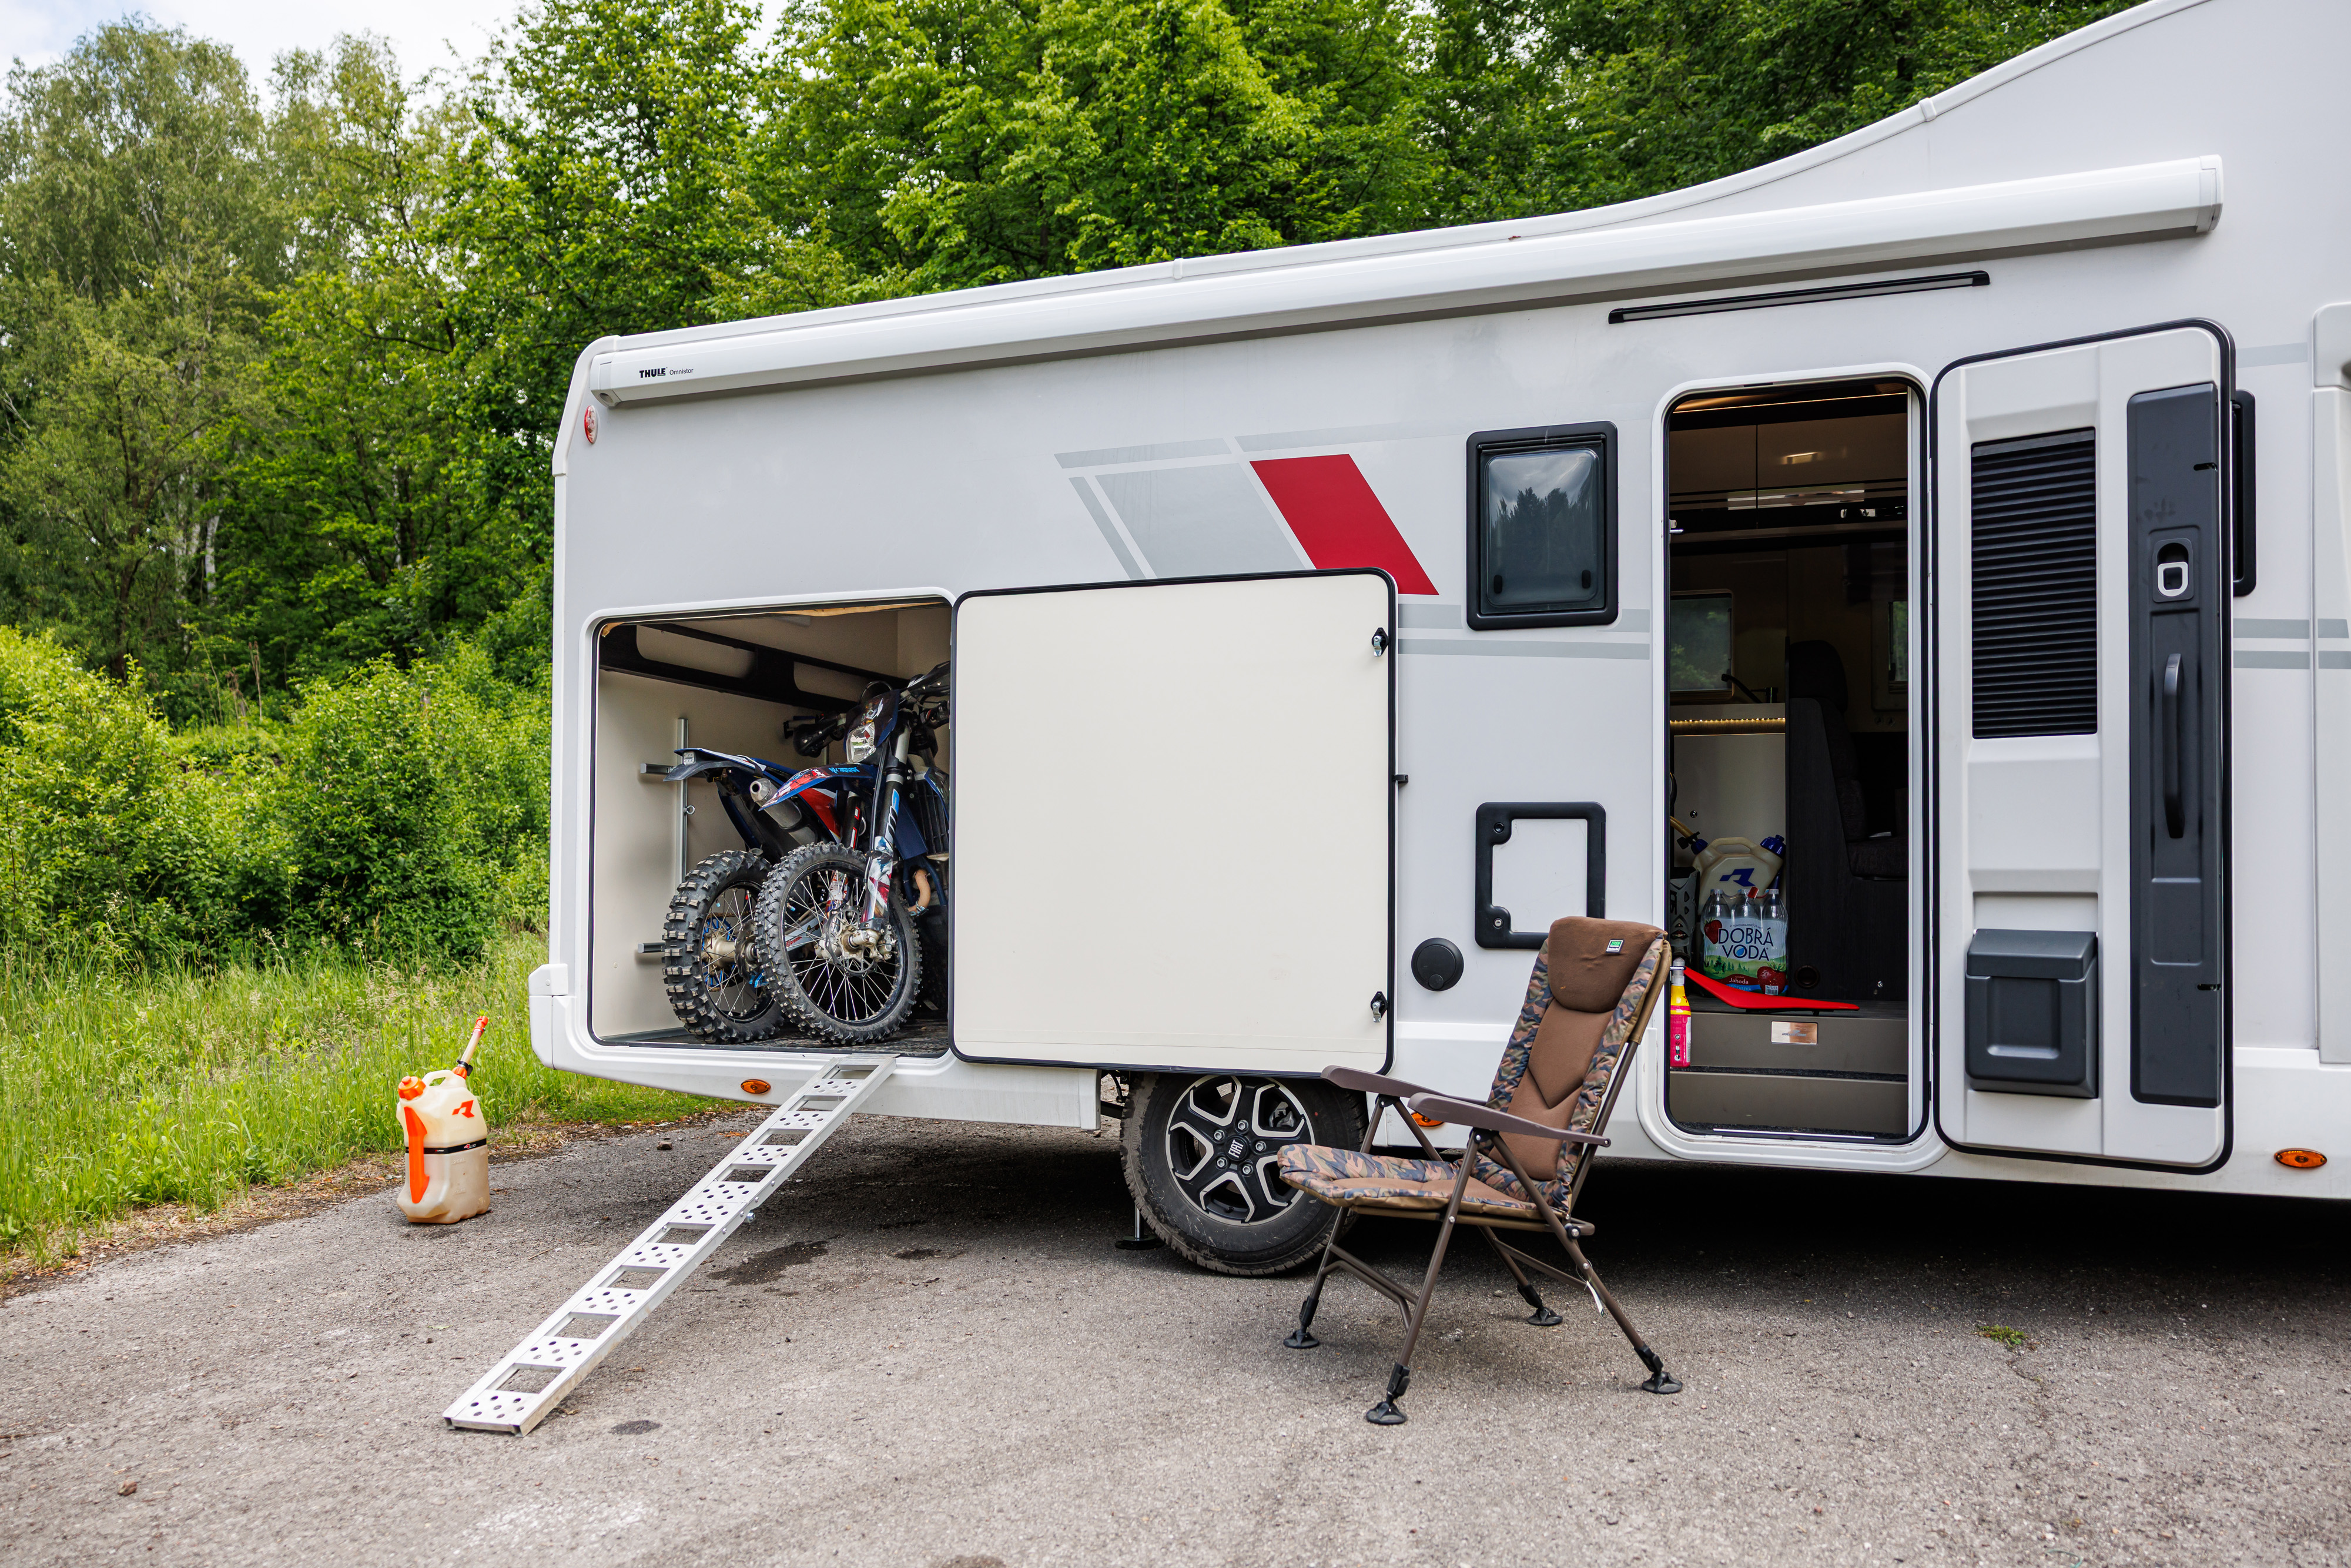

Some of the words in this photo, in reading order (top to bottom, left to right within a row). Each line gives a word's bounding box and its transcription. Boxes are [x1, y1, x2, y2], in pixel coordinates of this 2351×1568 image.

[639, 367, 666, 378] THULE
[1718, 927, 1774, 947] DOBRÁ
[1722, 944, 1770, 961] VODA
[1228, 1140, 1244, 1158] FIAT
